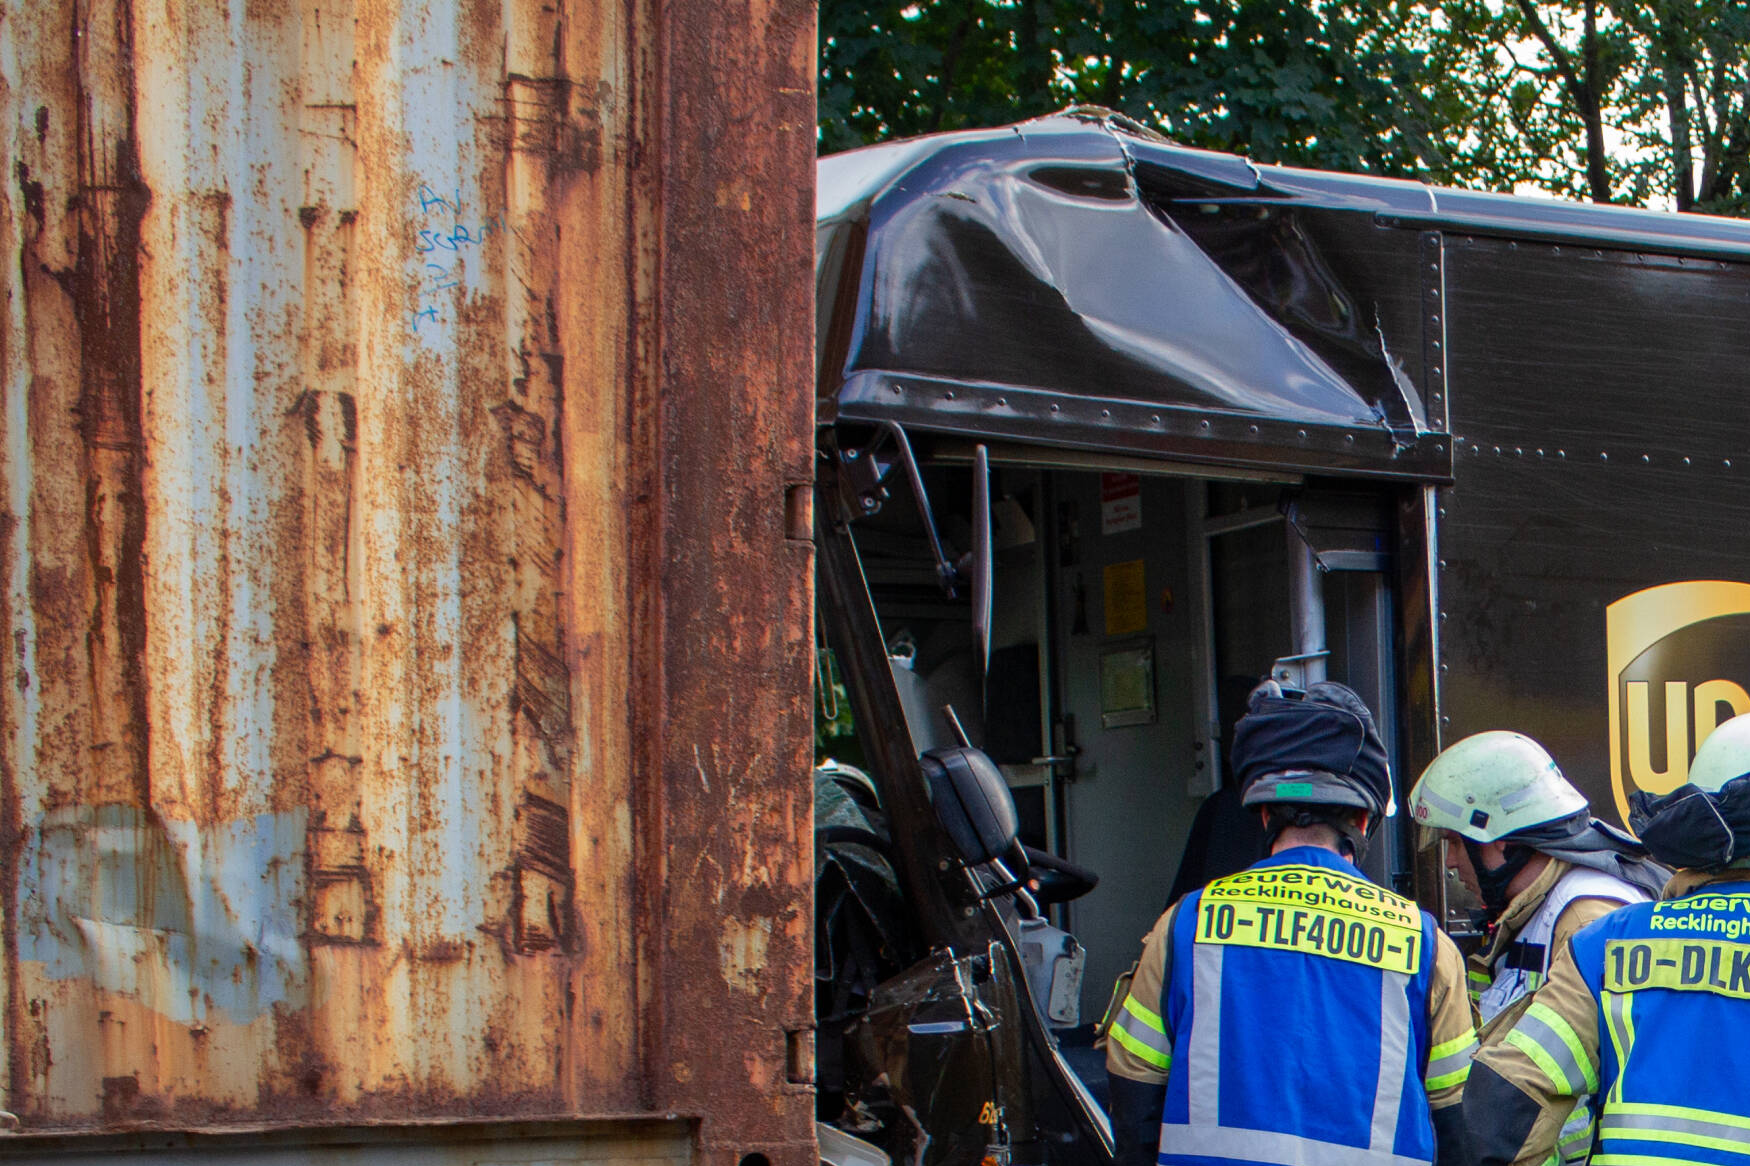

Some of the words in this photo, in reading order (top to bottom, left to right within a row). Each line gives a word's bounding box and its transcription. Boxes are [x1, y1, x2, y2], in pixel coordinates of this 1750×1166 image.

[1210, 884, 1413, 925] Recklinghausen
[1212, 867, 1412, 910] Feuerwehr
[1203, 902, 1416, 970] 10-TLF4000-1
